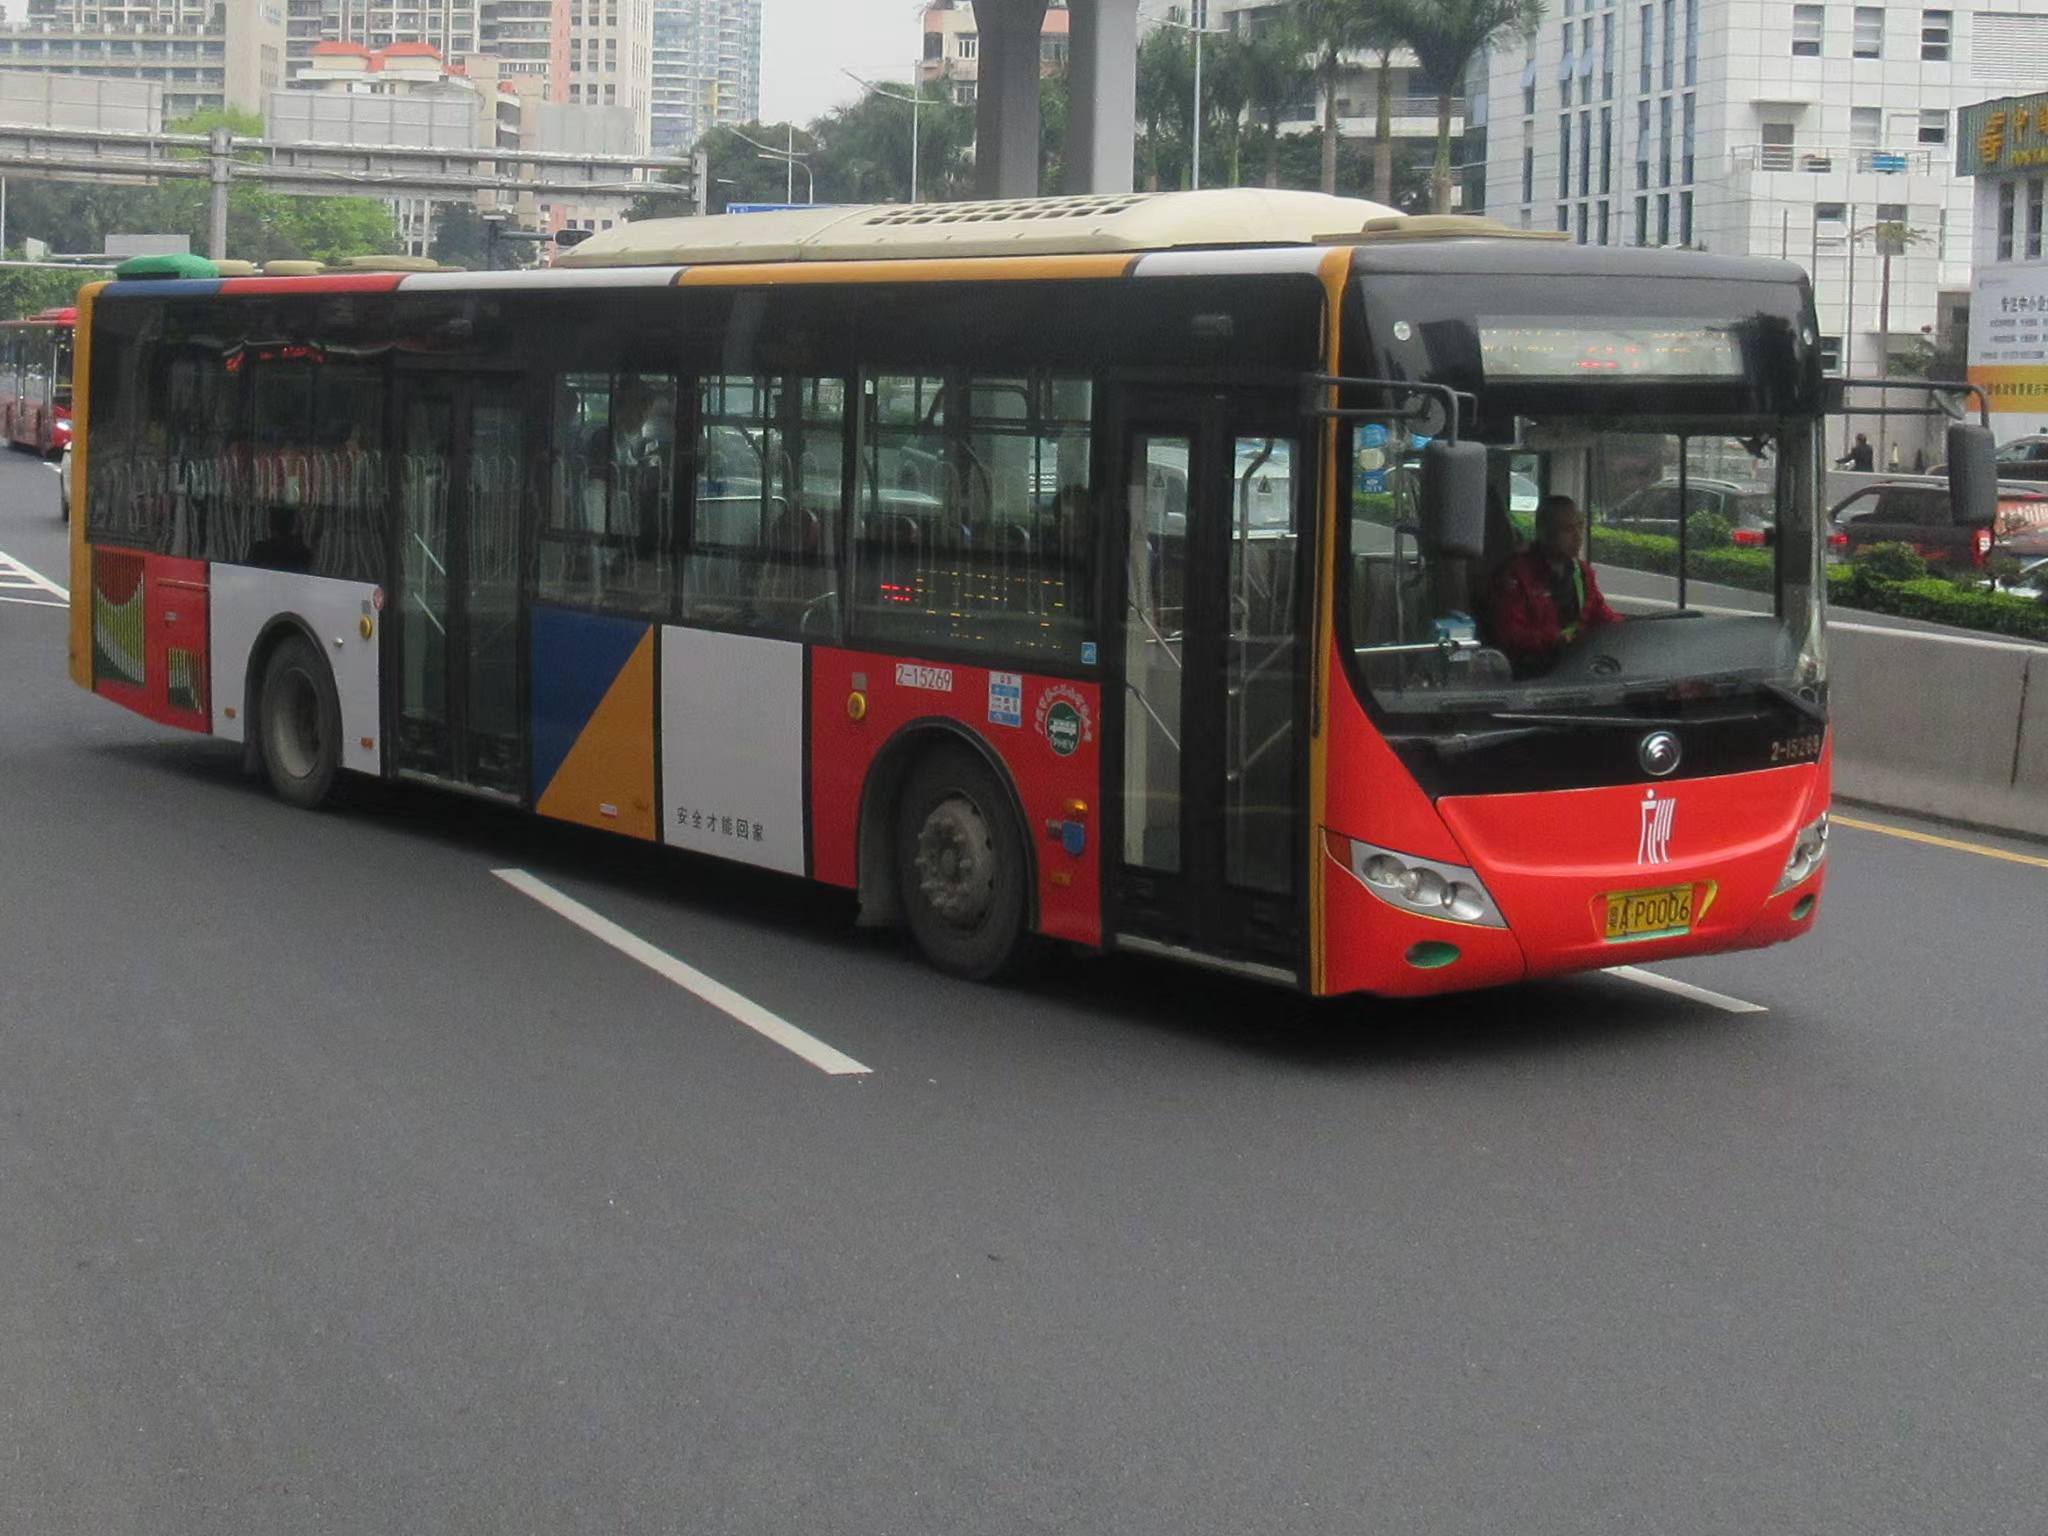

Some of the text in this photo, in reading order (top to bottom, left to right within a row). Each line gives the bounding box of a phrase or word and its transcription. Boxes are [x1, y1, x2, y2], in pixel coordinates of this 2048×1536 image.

[896, 665, 951, 690] 2-15269
[677, 806, 763, 841] 安全才能回家
